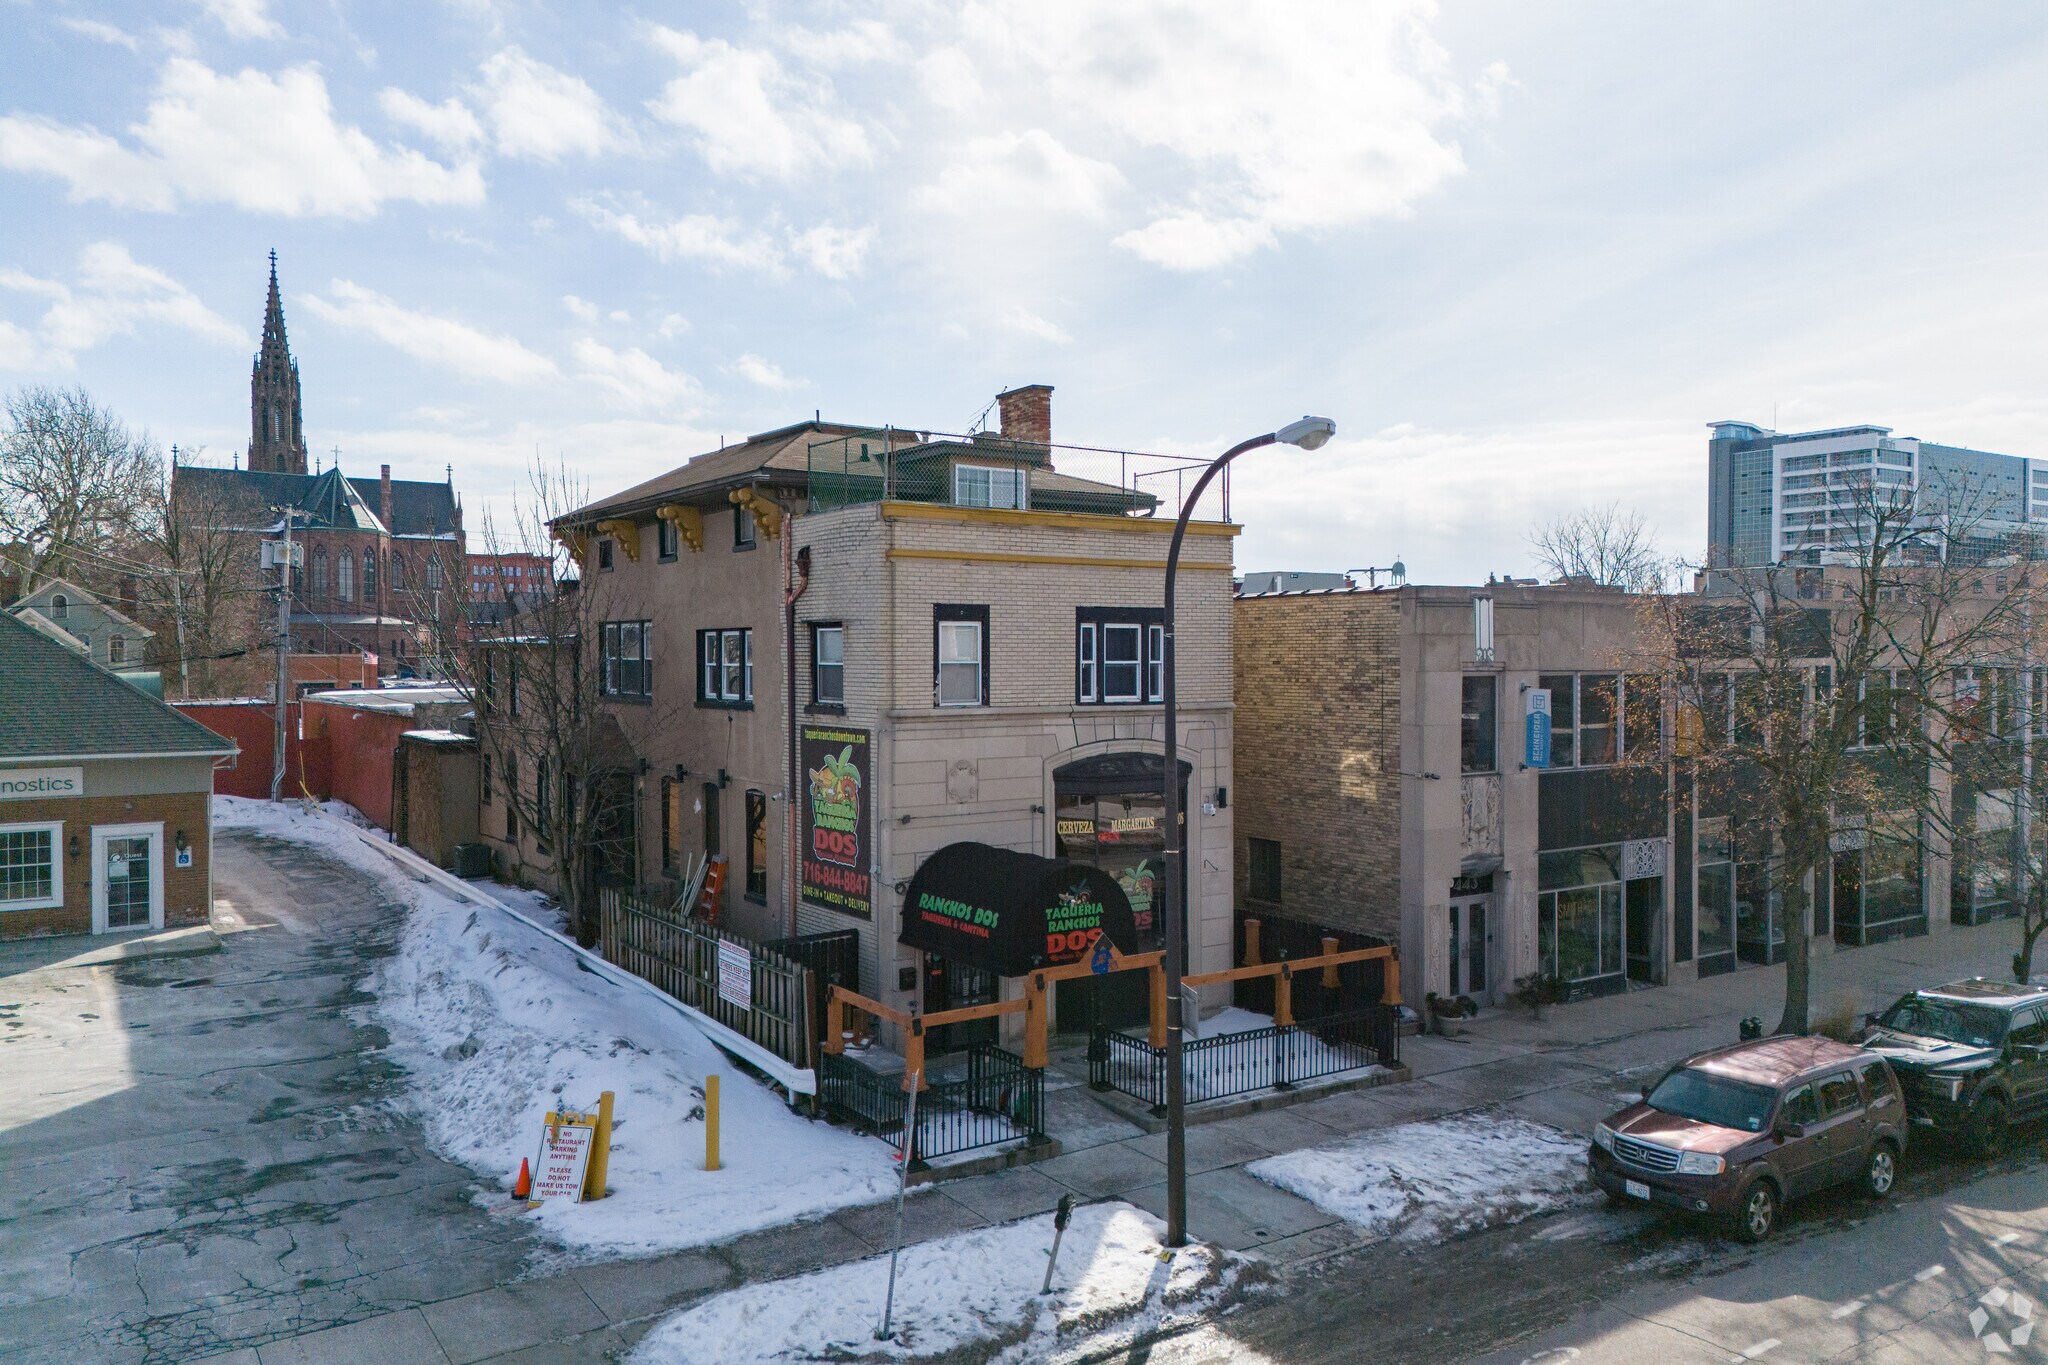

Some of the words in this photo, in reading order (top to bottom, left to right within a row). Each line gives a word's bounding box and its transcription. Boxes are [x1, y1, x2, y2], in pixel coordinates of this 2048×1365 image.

[1533, 713, 1541, 761] SCHNEIDER
[2, 777, 74, 793] nostics
[1057, 820, 1095, 834] CERVEZA
[1111, 816, 1155, 832] MARGARITAS
[815, 828, 857, 855] DOS
[1098, 831, 1120, 842] OPEN
[803, 860, 869, 896] 716-844-8847
[823, 890, 844, 905] TAKEOUT
[848, 897, 870, 913] DELIVERY
[919, 892, 972, 921] RANCHOS
[973, 907, 999, 929] DOS
[1045, 902, 1104, 920] TAQUERIA
[921, 910, 952, 928] TAQUERIA
[959, 921, 989, 939] CANTINA
[1048, 915, 1100, 933] RANCHOS
[1047, 927, 1104, 954] DOS
[549, 1153, 577, 1161] ANYTIME
[549, 1166, 572, 1174] PLEASE
